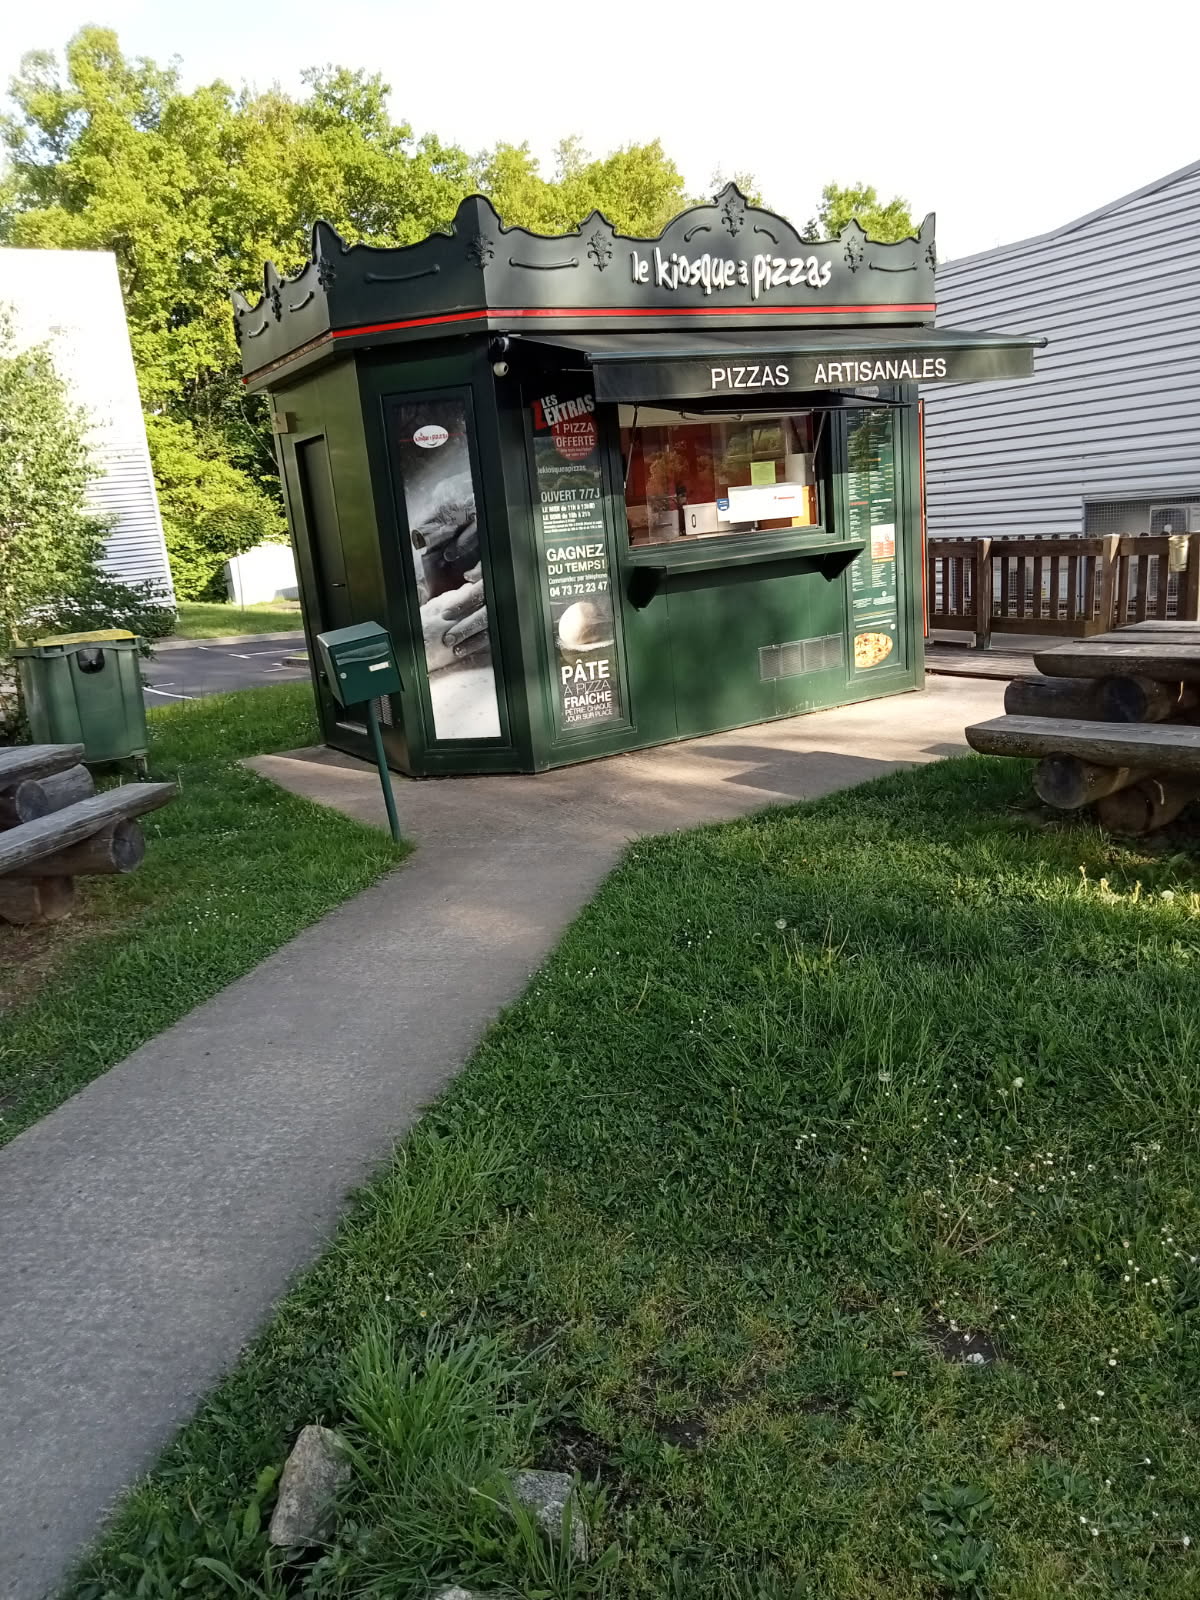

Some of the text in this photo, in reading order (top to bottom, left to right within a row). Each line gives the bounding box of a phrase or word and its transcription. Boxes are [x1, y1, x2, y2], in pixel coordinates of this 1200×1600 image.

[631, 247, 832, 300] le kiosque à pizzas
[711, 358, 947, 389] PIZZAS ARTISANALES
[541, 394, 558, 409] LES
[544, 394, 595, 426] EXTRAS
[555, 422, 594, 434] 1 PIZZA
[556, 435, 595, 448] OFFERTE
[541, 489, 576, 503] OUVERT
[546, 544, 604, 561] GAGNEZ
[548, 564, 563, 575] DU
[549, 581, 608, 597] 04 73 72 23 47
[561, 658, 610, 685] PÂTE
[576, 679, 611, 696] PIZZA
[564, 690, 612, 709] FRAÎCHE
